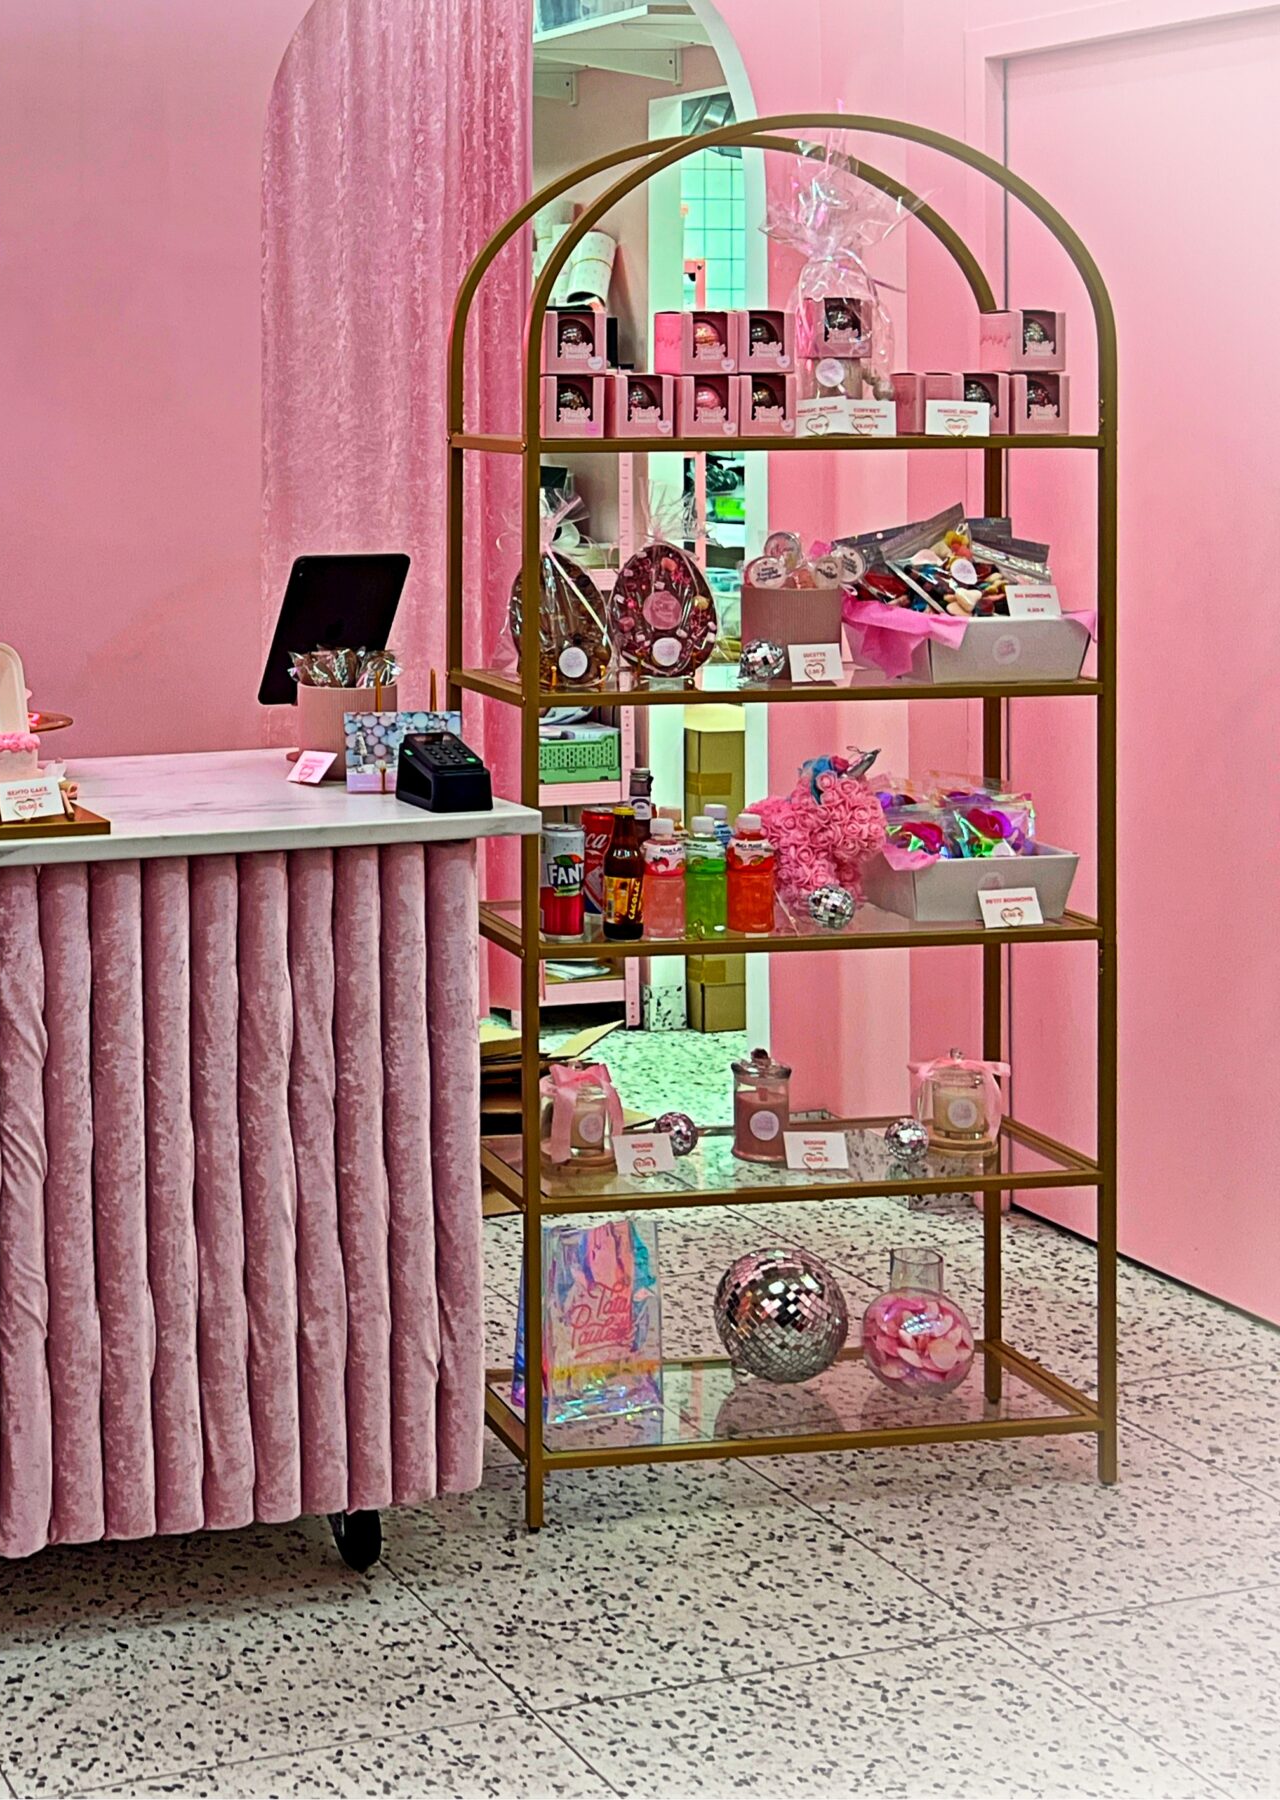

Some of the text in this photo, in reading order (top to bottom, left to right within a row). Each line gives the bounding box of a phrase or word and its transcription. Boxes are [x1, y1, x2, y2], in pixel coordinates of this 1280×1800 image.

[30, 786, 48, 794] CAKE
[548, 863, 585, 885] FANT
[628, 881, 642, 921] CACOLAC
